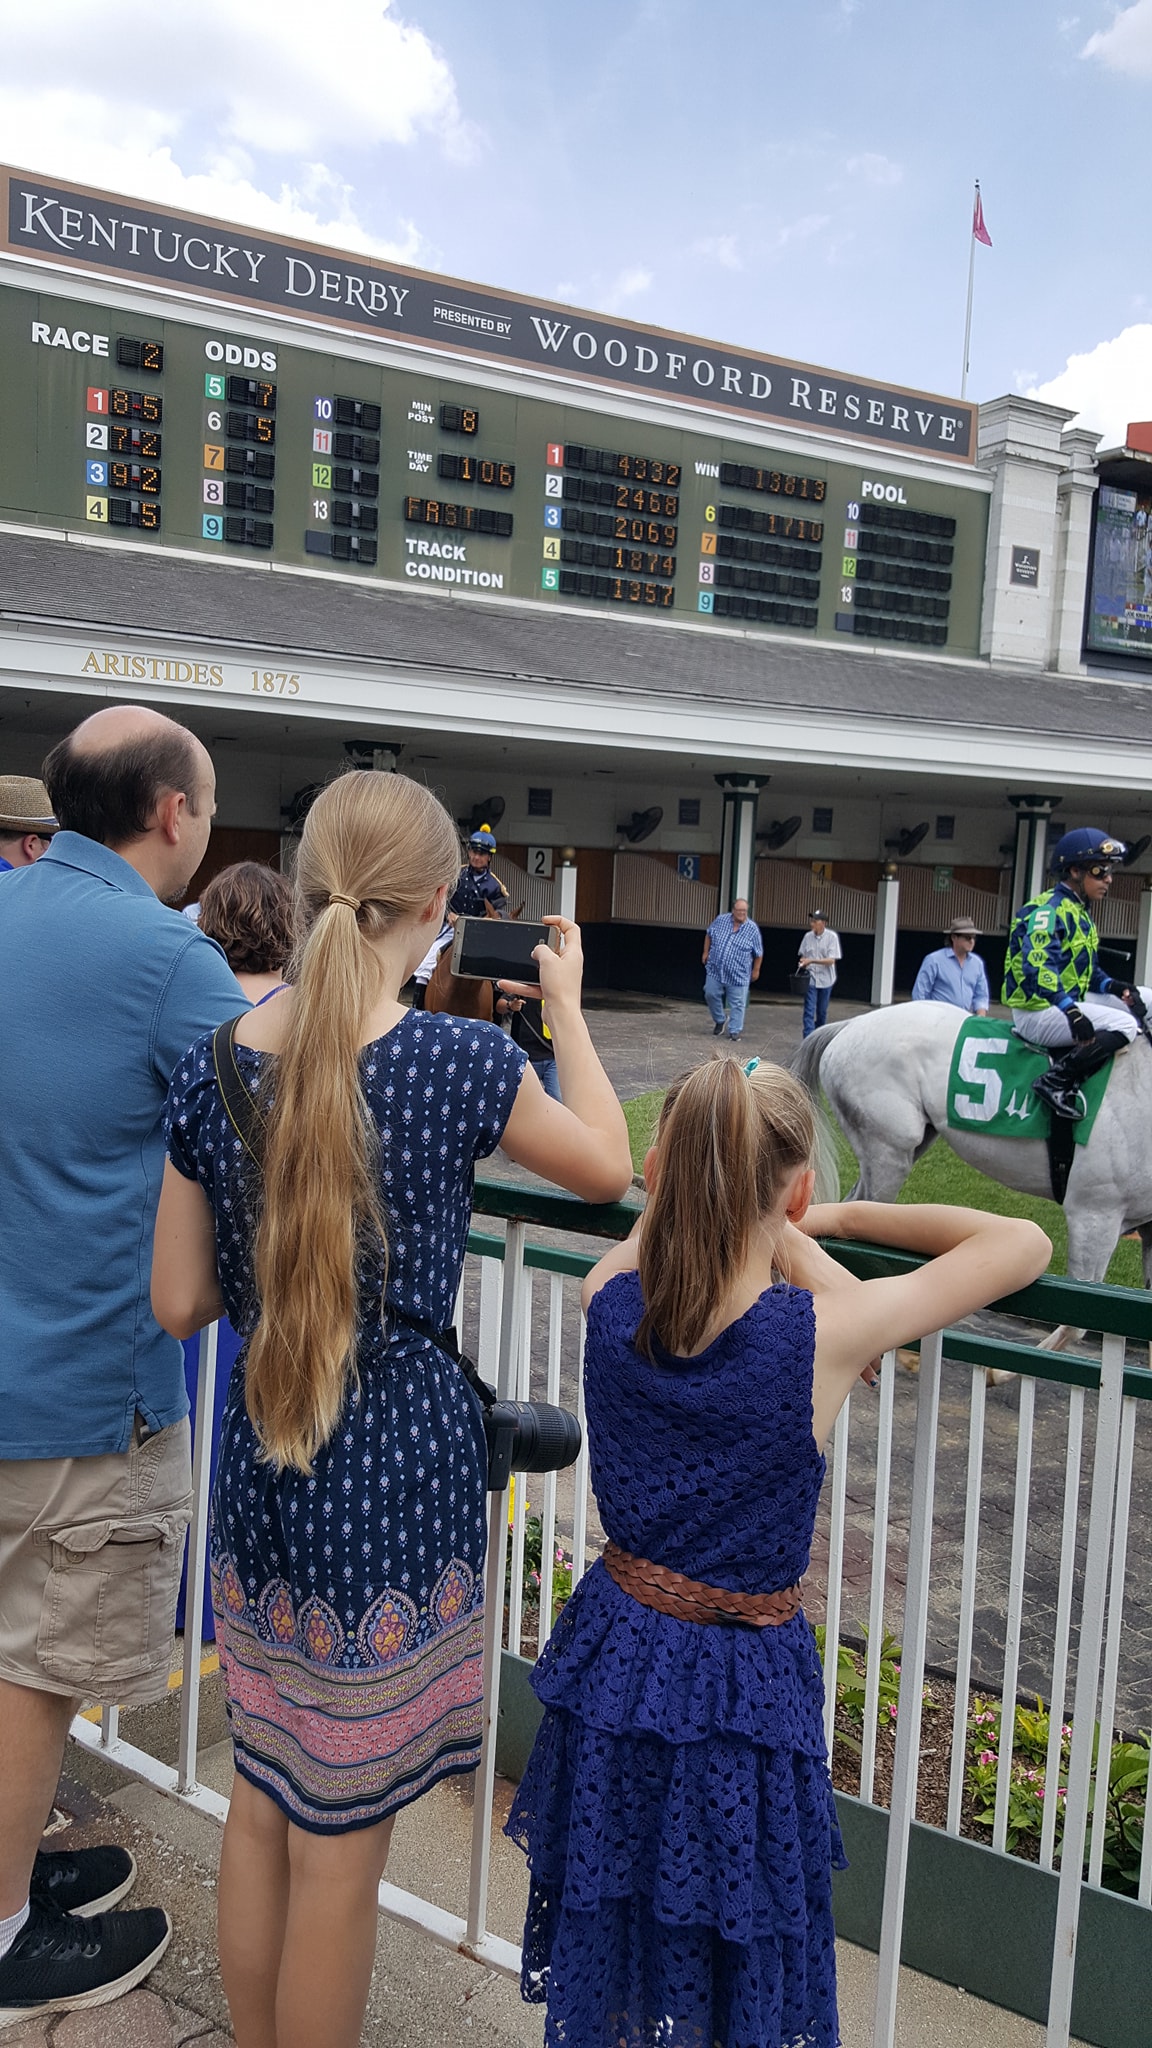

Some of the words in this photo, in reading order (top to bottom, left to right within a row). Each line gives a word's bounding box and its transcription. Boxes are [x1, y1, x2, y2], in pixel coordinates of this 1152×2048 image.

[20, 192, 265, 283] KENTUCKY
[284, 256, 410, 317] DERBY
[433, 306, 494, 331] PRESENTED
[497, 321, 512, 334] BY
[31, 321, 110, 357] RACE
[144, 343, 160, 369] 2
[204, 340, 277, 372] ODDS
[529, 316, 772, 399] WOODFORD
[93, 391, 103, 411] 1
[208, 377, 222, 396] 5
[259, 383, 273, 406] 7
[315, 399, 332, 419] 10
[412, 401, 431, 412] MIN
[207, 411, 222, 431] 6
[257, 417, 272, 441] 5
[407, 412, 435, 425] POST
[463, 409, 476, 432] 8
[89, 427, 103, 446] 2
[316, 431, 329, 452] 11
[208, 448, 221, 466] 7
[407, 450, 433, 463] TIME
[551, 447, 559, 464] 1
[618, 455, 679, 486] 4332
[90, 463, 104, 483] 3
[314, 466, 330, 486] 12
[408, 462, 429, 474] DAY
[694, 461, 719, 478] WIN
[756, 470, 825, 500] 13813
[206, 483, 219, 501] 8
[548, 478, 558, 494] 2
[616, 486, 677, 516] 2468
[861, 480, 907, 505] POOL
[89, 501, 104, 519] 4
[142, 502, 157, 527] 5
[313, 500, 328, 520] 13
[407, 496, 474, 528] FAST
[705, 505, 716, 522] 6
[847, 502, 860, 520] 10
[206, 518, 219, 536] 9
[547, 508, 558, 525] 3
[615, 516, 676, 546] 2069
[704, 535, 714, 551] 7
[847, 531, 856, 546] 11
[405, 538, 467, 562] TRACK
[546, 542, 557, 557] 4
[615, 547, 673, 576] 1874
[404, 561, 504, 589] CONDITION
[702, 565, 711, 581] 8
[844, 559, 855, 575] 12
[545, 571, 556, 587] 5
[614, 578, 673, 606] 1357
[841, 586, 852, 603] 13
[701, 594, 711, 609] 9
[81, 651, 225, 687] ARISTIDES
[251, 670, 301, 695] 1875
[534, 850, 545, 875] 2
[683, 857, 695, 880] 3
[817, 864, 826, 885] 4
[938, 869, 950, 887] 5
[1033, 910, 1051, 930] 5
[1035, 934, 1046, 945] M
[1032, 952, 1044, 962] W
[954, 1037, 1009, 1121] 5
